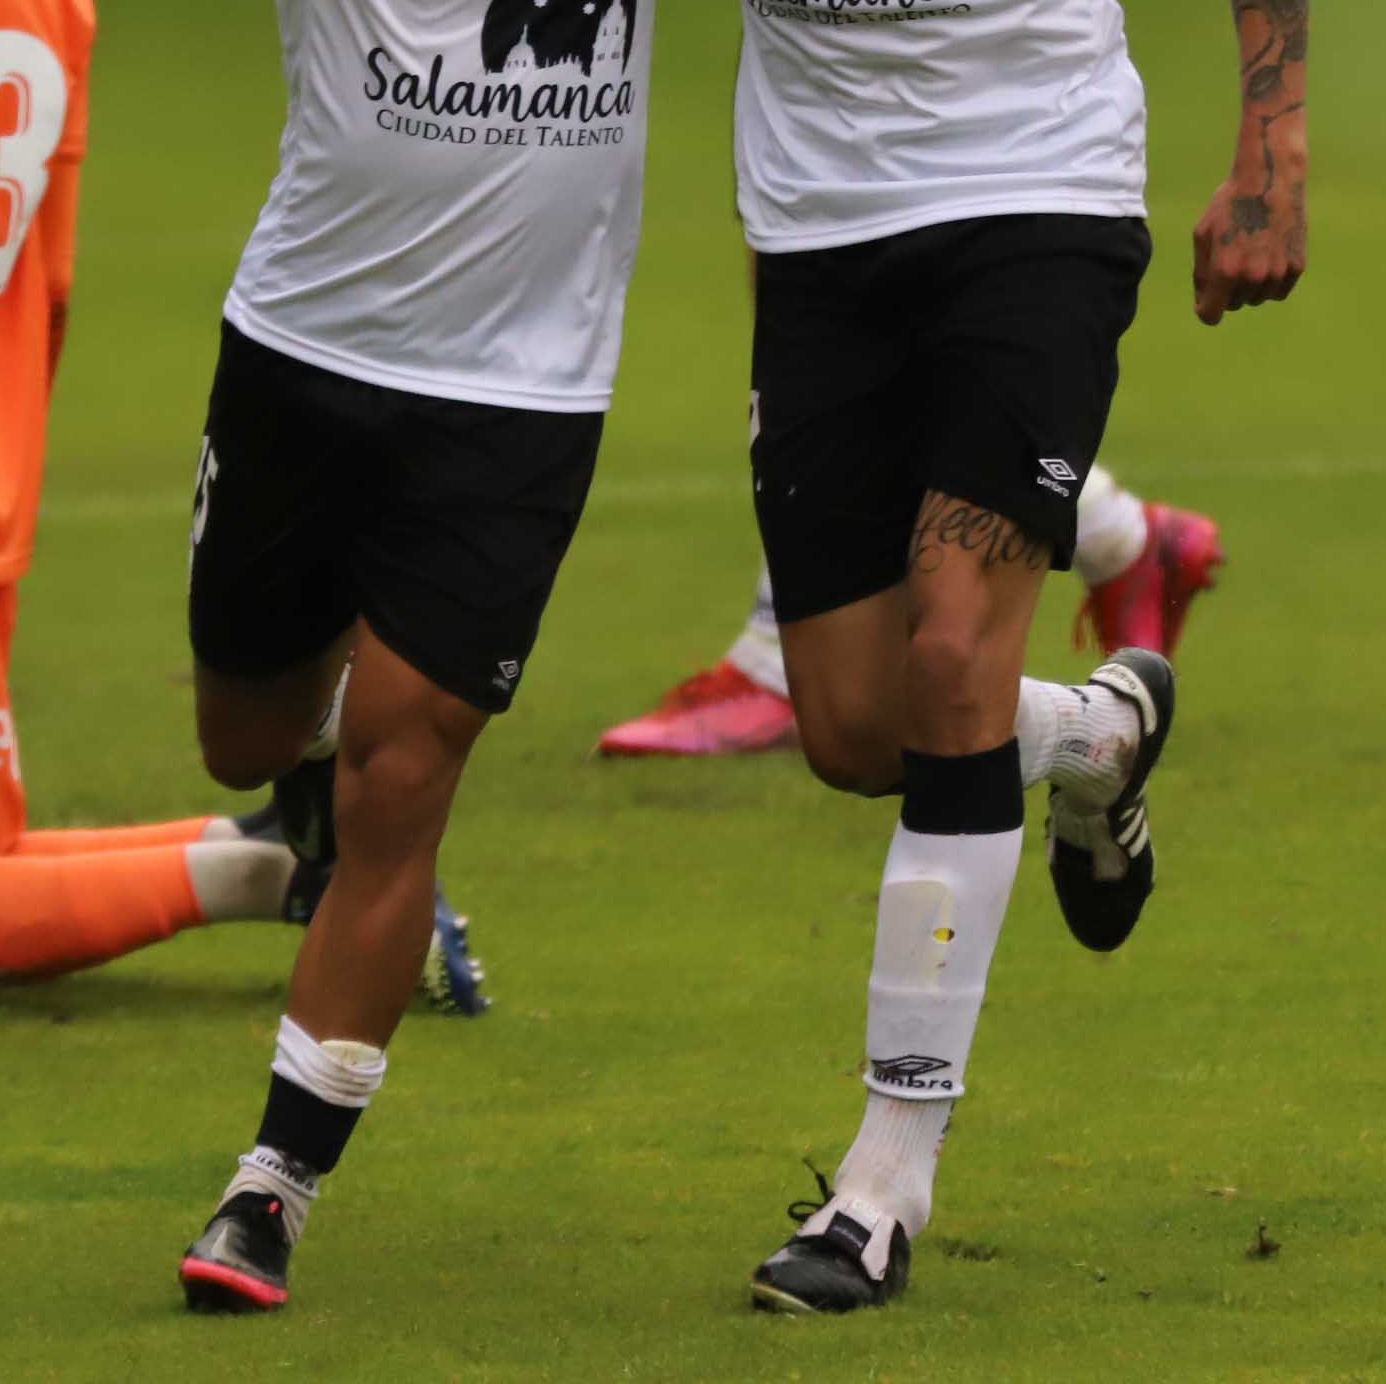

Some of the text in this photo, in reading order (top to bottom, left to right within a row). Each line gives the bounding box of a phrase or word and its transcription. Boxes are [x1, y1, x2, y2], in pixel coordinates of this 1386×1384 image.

[364, 47, 635, 123] Salamanca
[376, 108, 625, 147] CIUDAD DEL TALENTO
